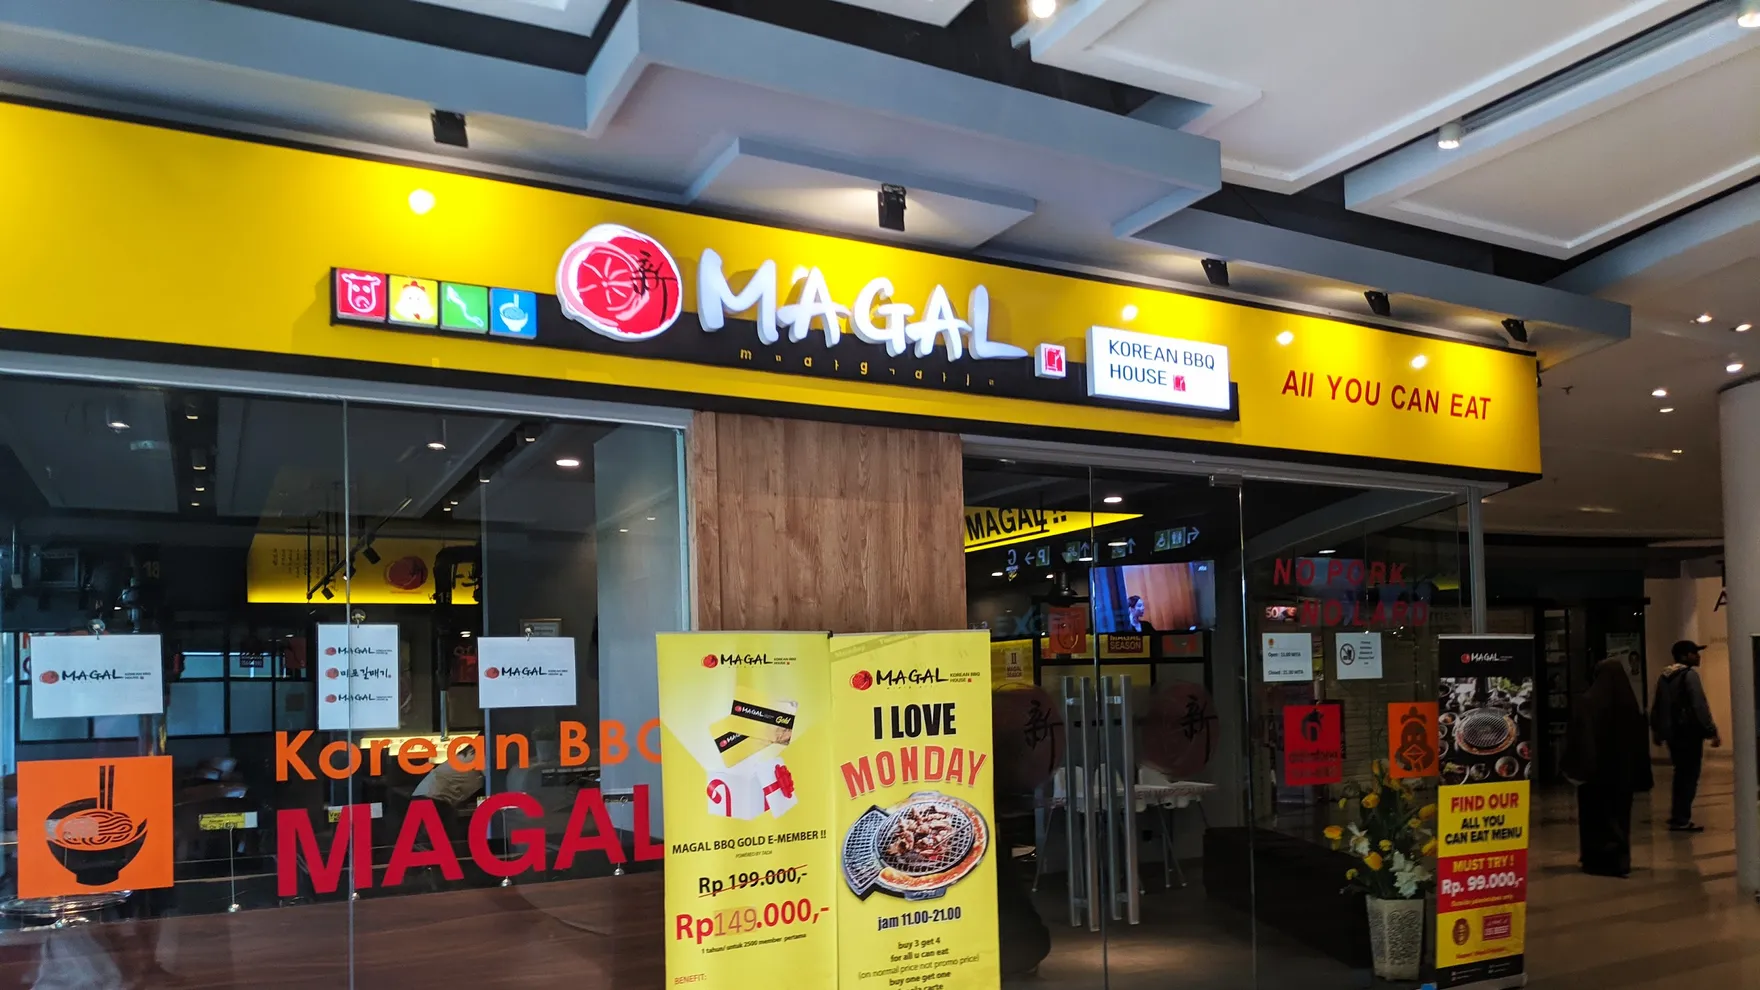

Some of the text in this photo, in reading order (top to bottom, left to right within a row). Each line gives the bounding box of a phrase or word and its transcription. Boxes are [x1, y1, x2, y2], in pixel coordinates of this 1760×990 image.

[696, 247, 1029, 362] MAGAL
[1108, 339, 1215, 370] KOREAN BBQ
[1110, 364, 1167, 386] HOUSE
[1281, 370, 1491, 420] All YOU CAN EAT
[1273, 558, 1408, 587] NO PORK
[1301, 599, 1343, 626] NO
[1351, 601, 1428, 626] LARD
[338, 646, 375, 655] MAGAL
[1110, 641, 1141, 650] SEASON
[721, 653, 773, 665] MAGAL
[1471, 653, 1499, 662] MAGAL
[61, 669, 123, 681] MAGAL
[501, 666, 548, 677] MAGAL
[876, 667, 949, 686] MAGAL
[338, 693, 375, 702] MAGAL
[873, 702, 957, 740] I LOVE
[276, 729, 529, 783] Korean
[840, 745, 988, 799] MONDAY
[1451, 792, 1519, 814] FIND OUR
[1461, 814, 1505, 830] ALL YOU
[276, 783, 666, 898] MAGAL
[672, 829, 827, 855] MAGAL BBQ GOLD E-MEMBER !!
[1445, 826, 1522, 845] CAN EAT MENU
[1452, 854, 1515, 873] MUST TRY !
[699, 866, 808, 897] Rp 199.000,-
[1441, 871, 1524, 898] Rp. 99.000,-
[878, 906, 962, 932] jam 11.00-21.00
[743, 940, 758, 948] 2500
[758, 936, 783, 946] member
[898, 936, 941, 950] buy 3 get 4
[872, 965, 900, 978] normal
[900, 962, 919, 975] price
[919, 961, 933, 971] not
[934, 958, 959, 971] promo
[959, 953, 980, 968] price)
[890, 954, 902, 963] for
[903, 951, 913, 960] all
[921, 950, 936, 959] can
[936, 948, 950, 957] eat
[673, 973, 708, 986] BENEFIT:
[888, 971, 952, 987] buy one get one
